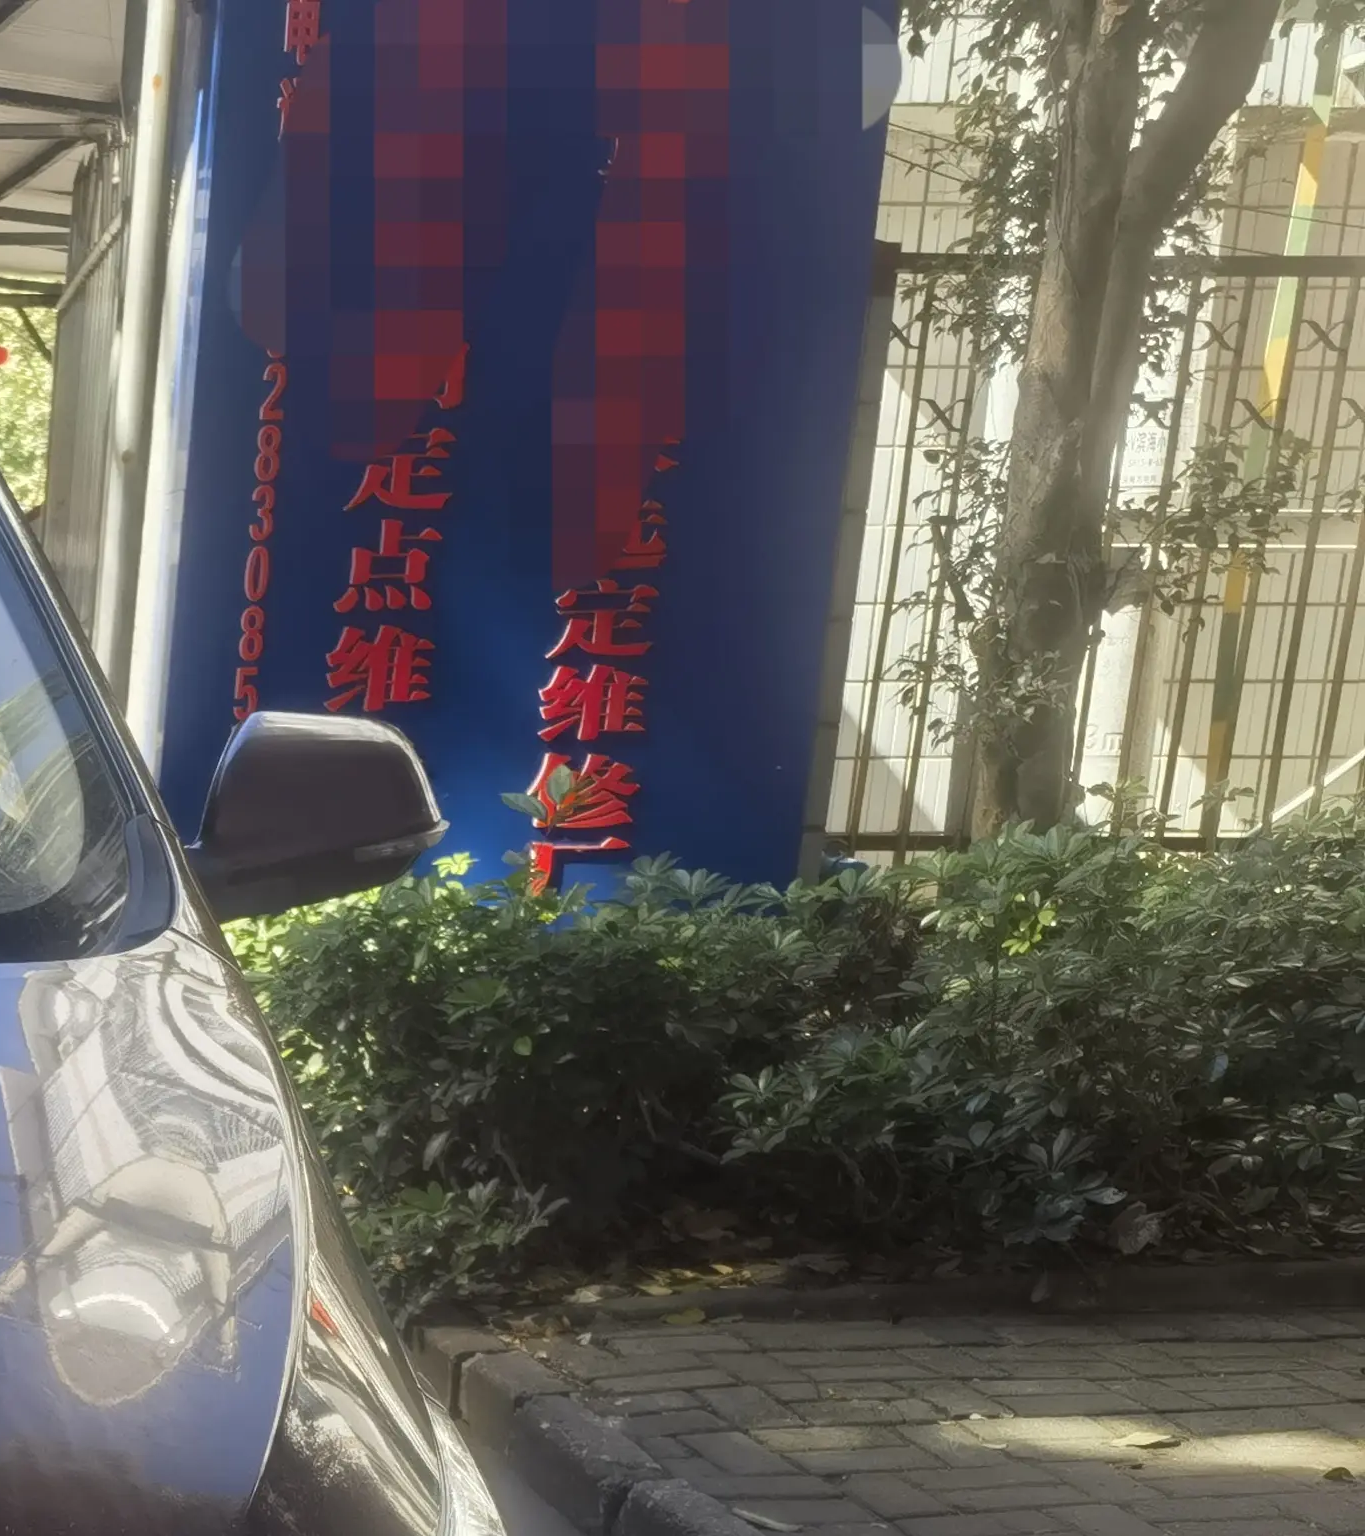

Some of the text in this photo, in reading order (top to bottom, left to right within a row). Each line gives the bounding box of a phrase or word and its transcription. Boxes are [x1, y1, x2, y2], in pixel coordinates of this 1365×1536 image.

[233, 346, 288, 720] 283085
[324, 342, 471, 713] 定点维
